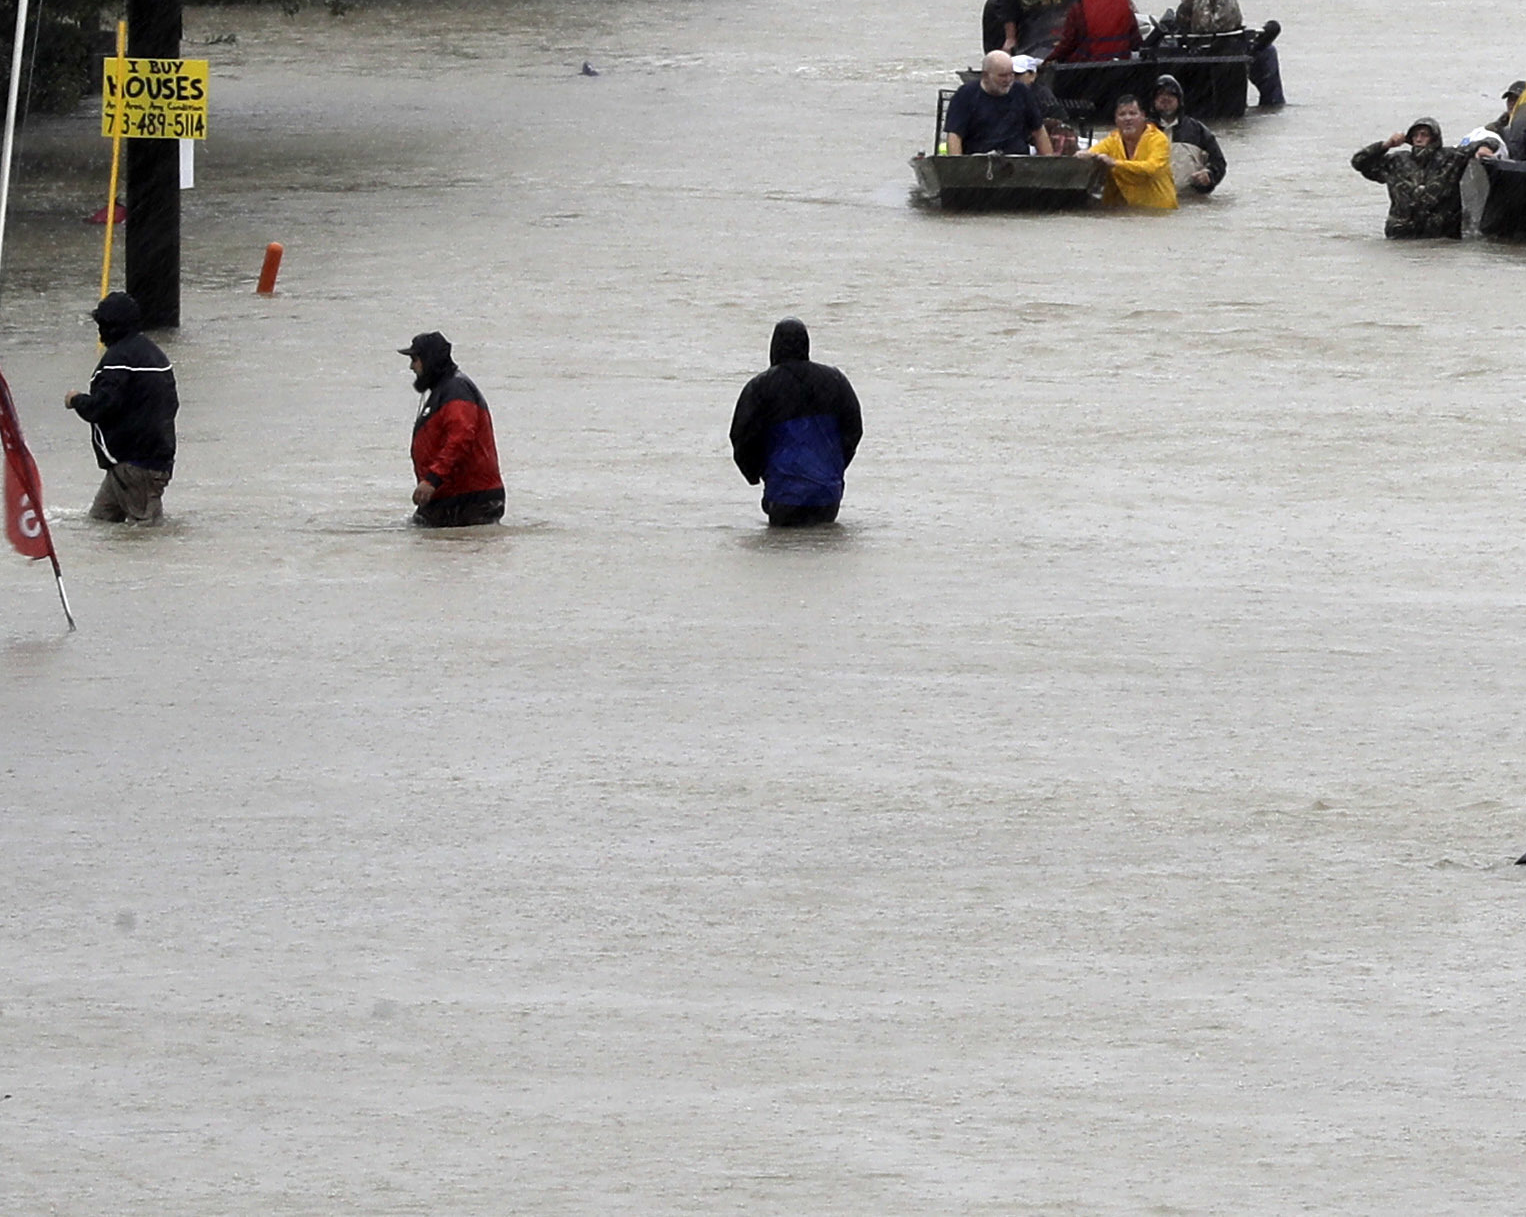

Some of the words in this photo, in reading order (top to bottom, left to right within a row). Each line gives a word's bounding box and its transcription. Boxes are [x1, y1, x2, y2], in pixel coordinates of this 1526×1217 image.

[128, 60, 139, 73] I
[149, 60, 184, 74] BUY
[105, 113, 204, 137] 73-489-5114
